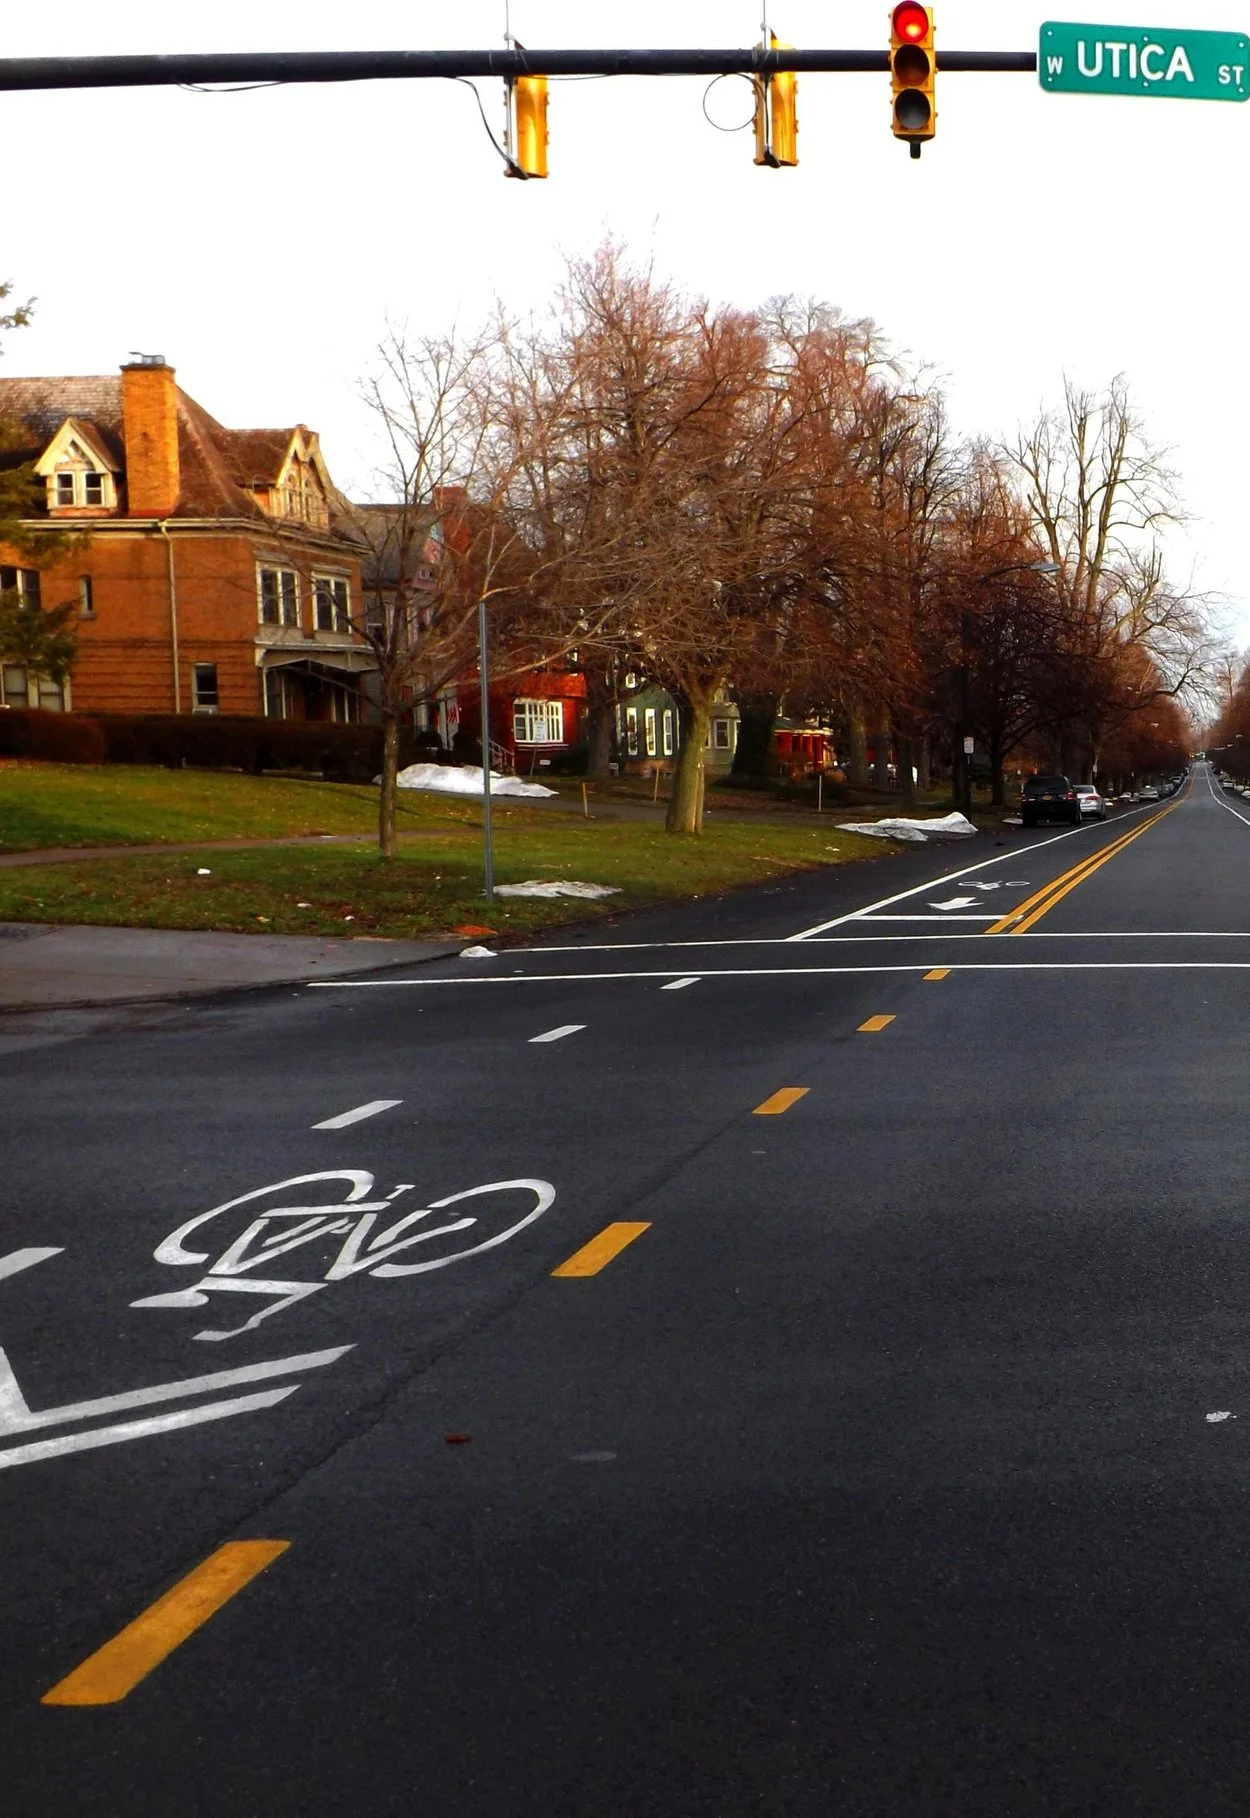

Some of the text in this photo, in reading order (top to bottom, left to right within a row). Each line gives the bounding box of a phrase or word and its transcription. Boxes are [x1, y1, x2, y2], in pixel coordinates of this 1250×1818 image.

[1047, 40, 1244, 85] W UTICA ST
